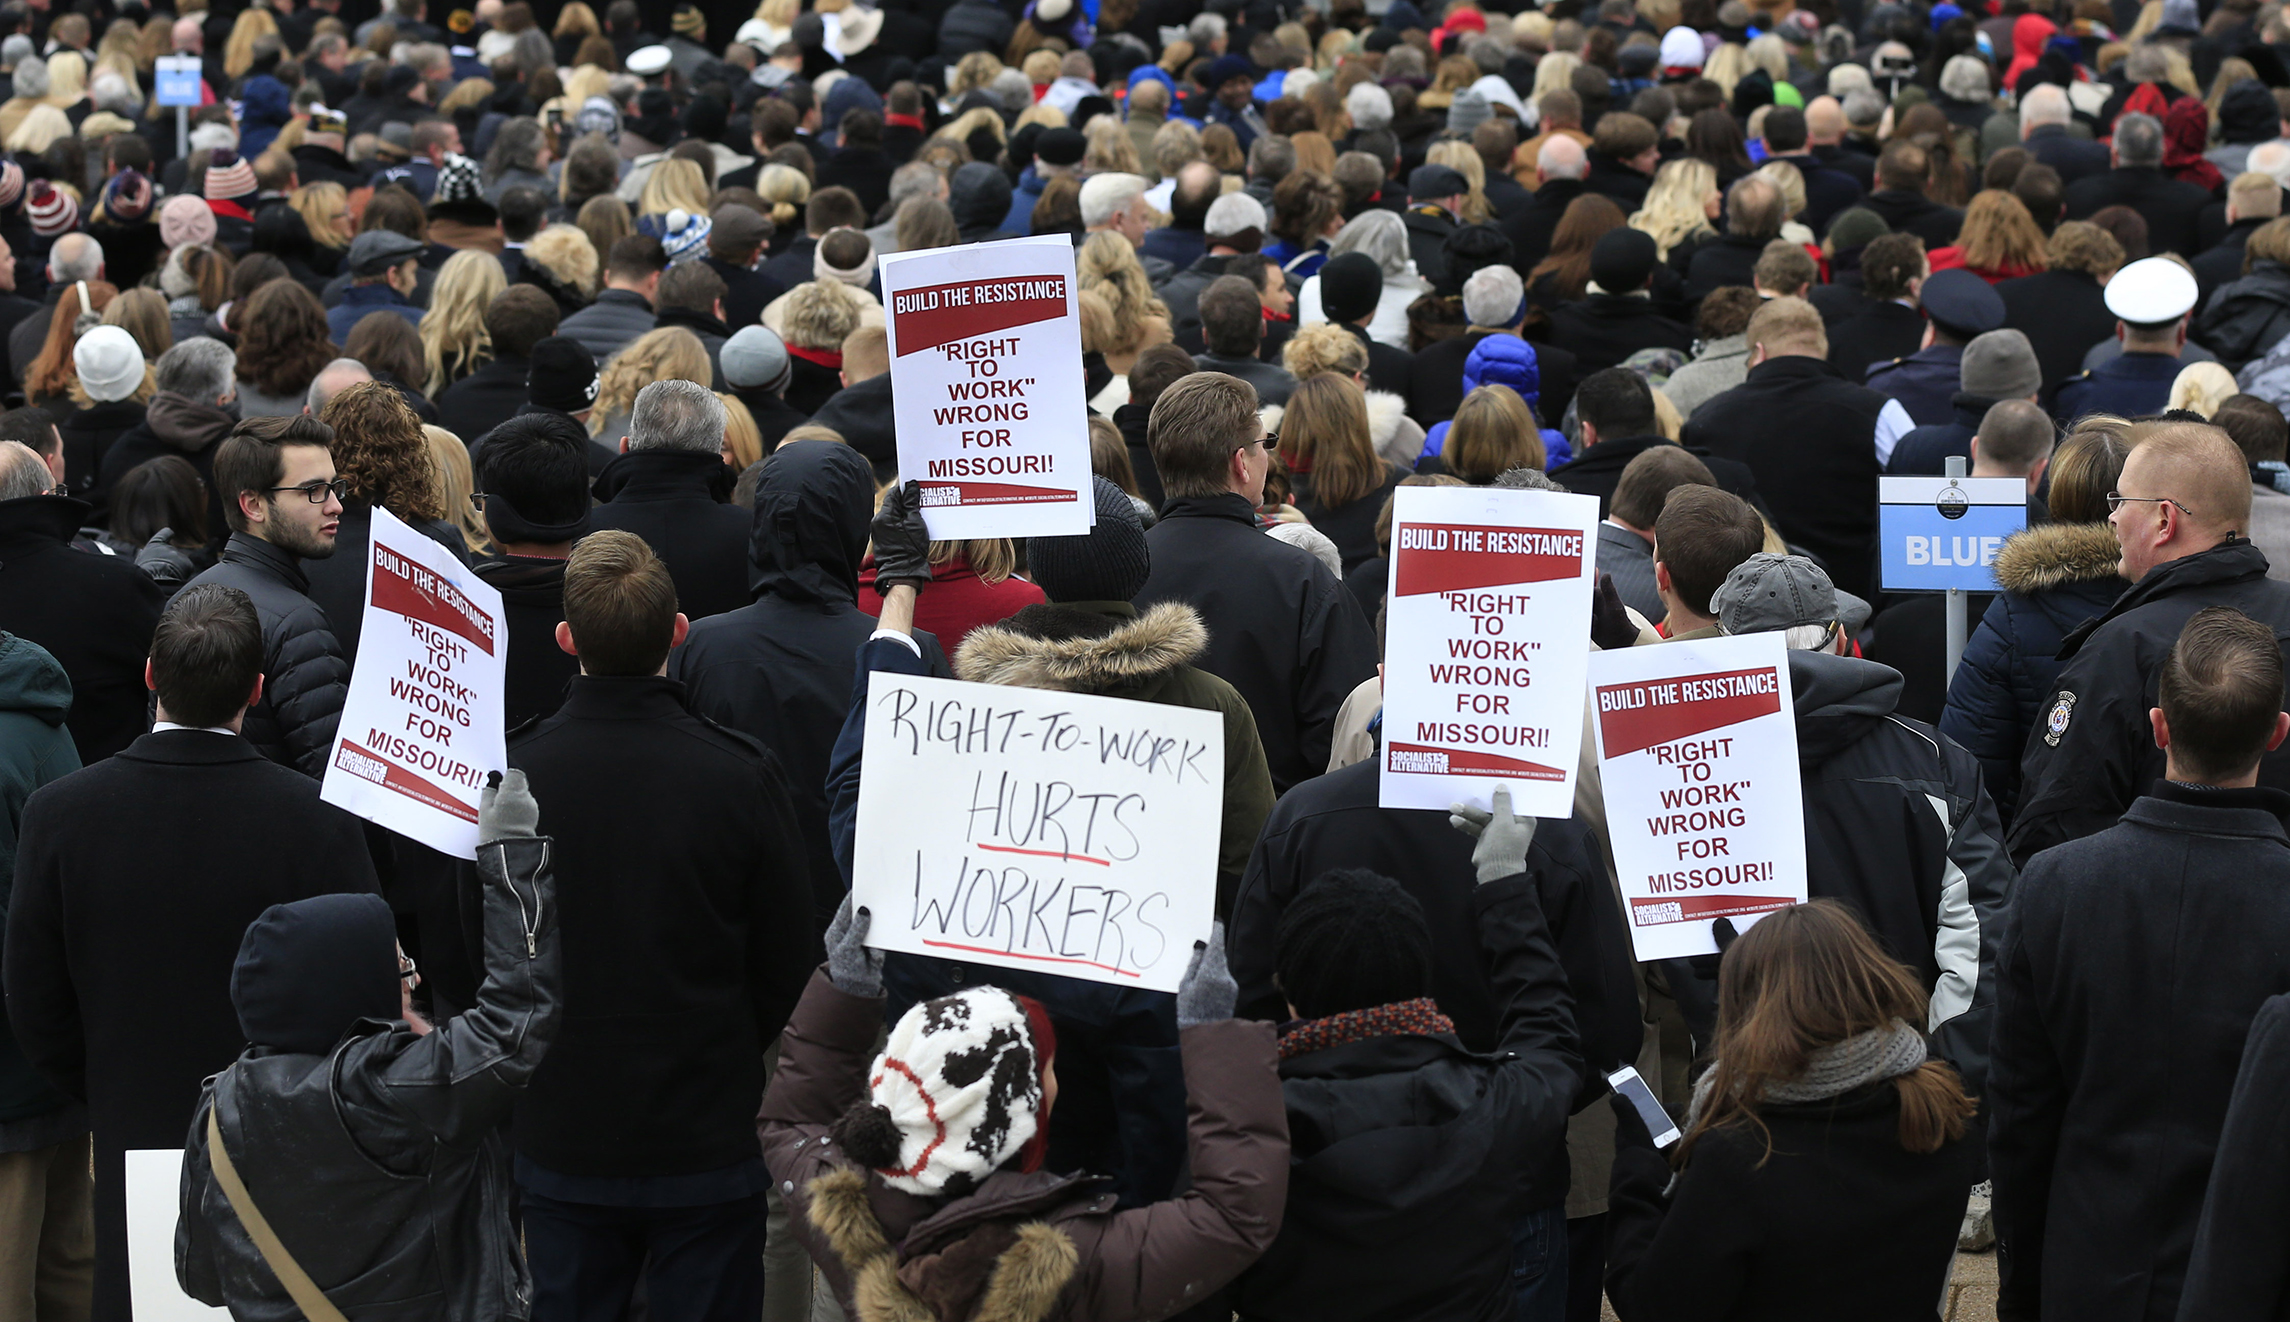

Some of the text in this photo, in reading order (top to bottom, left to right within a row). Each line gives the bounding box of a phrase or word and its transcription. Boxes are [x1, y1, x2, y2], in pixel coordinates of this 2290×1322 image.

[896, 280, 1066, 315] BUILD THE RESISTANCE
[936, 338, 1021, 361] "RIGHT
[965, 360, 999, 378] TO
[947, 378, 1036, 401] WORK"
[933, 402, 1029, 425] WRONG
[961, 429, 1012, 449] FOR
[928, 455, 1054, 478] MISSOURI!
[919, 487, 951, 497] CIALIST
[919, 496, 962, 506] TERNATIVE
[1400, 528, 1582, 557] BUILD THE RESISTANCE
[1906, 535, 2001, 567] BLUE
[376, 547, 493, 640] BUILD THE RESISTANCE
[1440, 592, 1530, 615] "RIGHT
[1469, 615, 1504, 635] TO
[404, 615, 468, 664] "RIGHT
[1448, 639, 1541, 661] WORK"
[426, 647, 451, 672] TO
[408, 660, 478, 705] WORK"
[1429, 664, 1531, 688] WRONG
[390, 677, 471, 728] WRONG
[1456, 693, 1510, 715] FOR
[1600, 672, 1777, 712] BUILD THE RESISTANCE
[406, 713, 452, 747] FOR
[878, 688, 1209, 784] RIGHT-TO-WORK
[1416, 722, 1549, 748] MISSOURI!
[340, 747, 378, 771] SOCIALIST
[366, 728, 482, 790] MISSOURI!
[1391, 751, 1438, 763] SOCIALIST
[1646, 738, 1733, 765] "RIGHT
[337, 756, 386, 786] ALTERNATIVE
[1390, 761, 1449, 774] ALTERNATIVE
[1677, 763, 1711, 783] TO
[1660, 781, 1751, 809] WORK"
[967, 770, 1145, 862] HURTS
[1647, 808, 1746, 837] WRONG
[1677, 837, 1730, 861] FOR
[1648, 862, 1773, 894] MISSOURI!
[911, 849, 1169, 975] WORKERS
[1634, 902, 1671, 915] SOCIALIST
[1637, 910, 1684, 925] ALTERNATIVE
